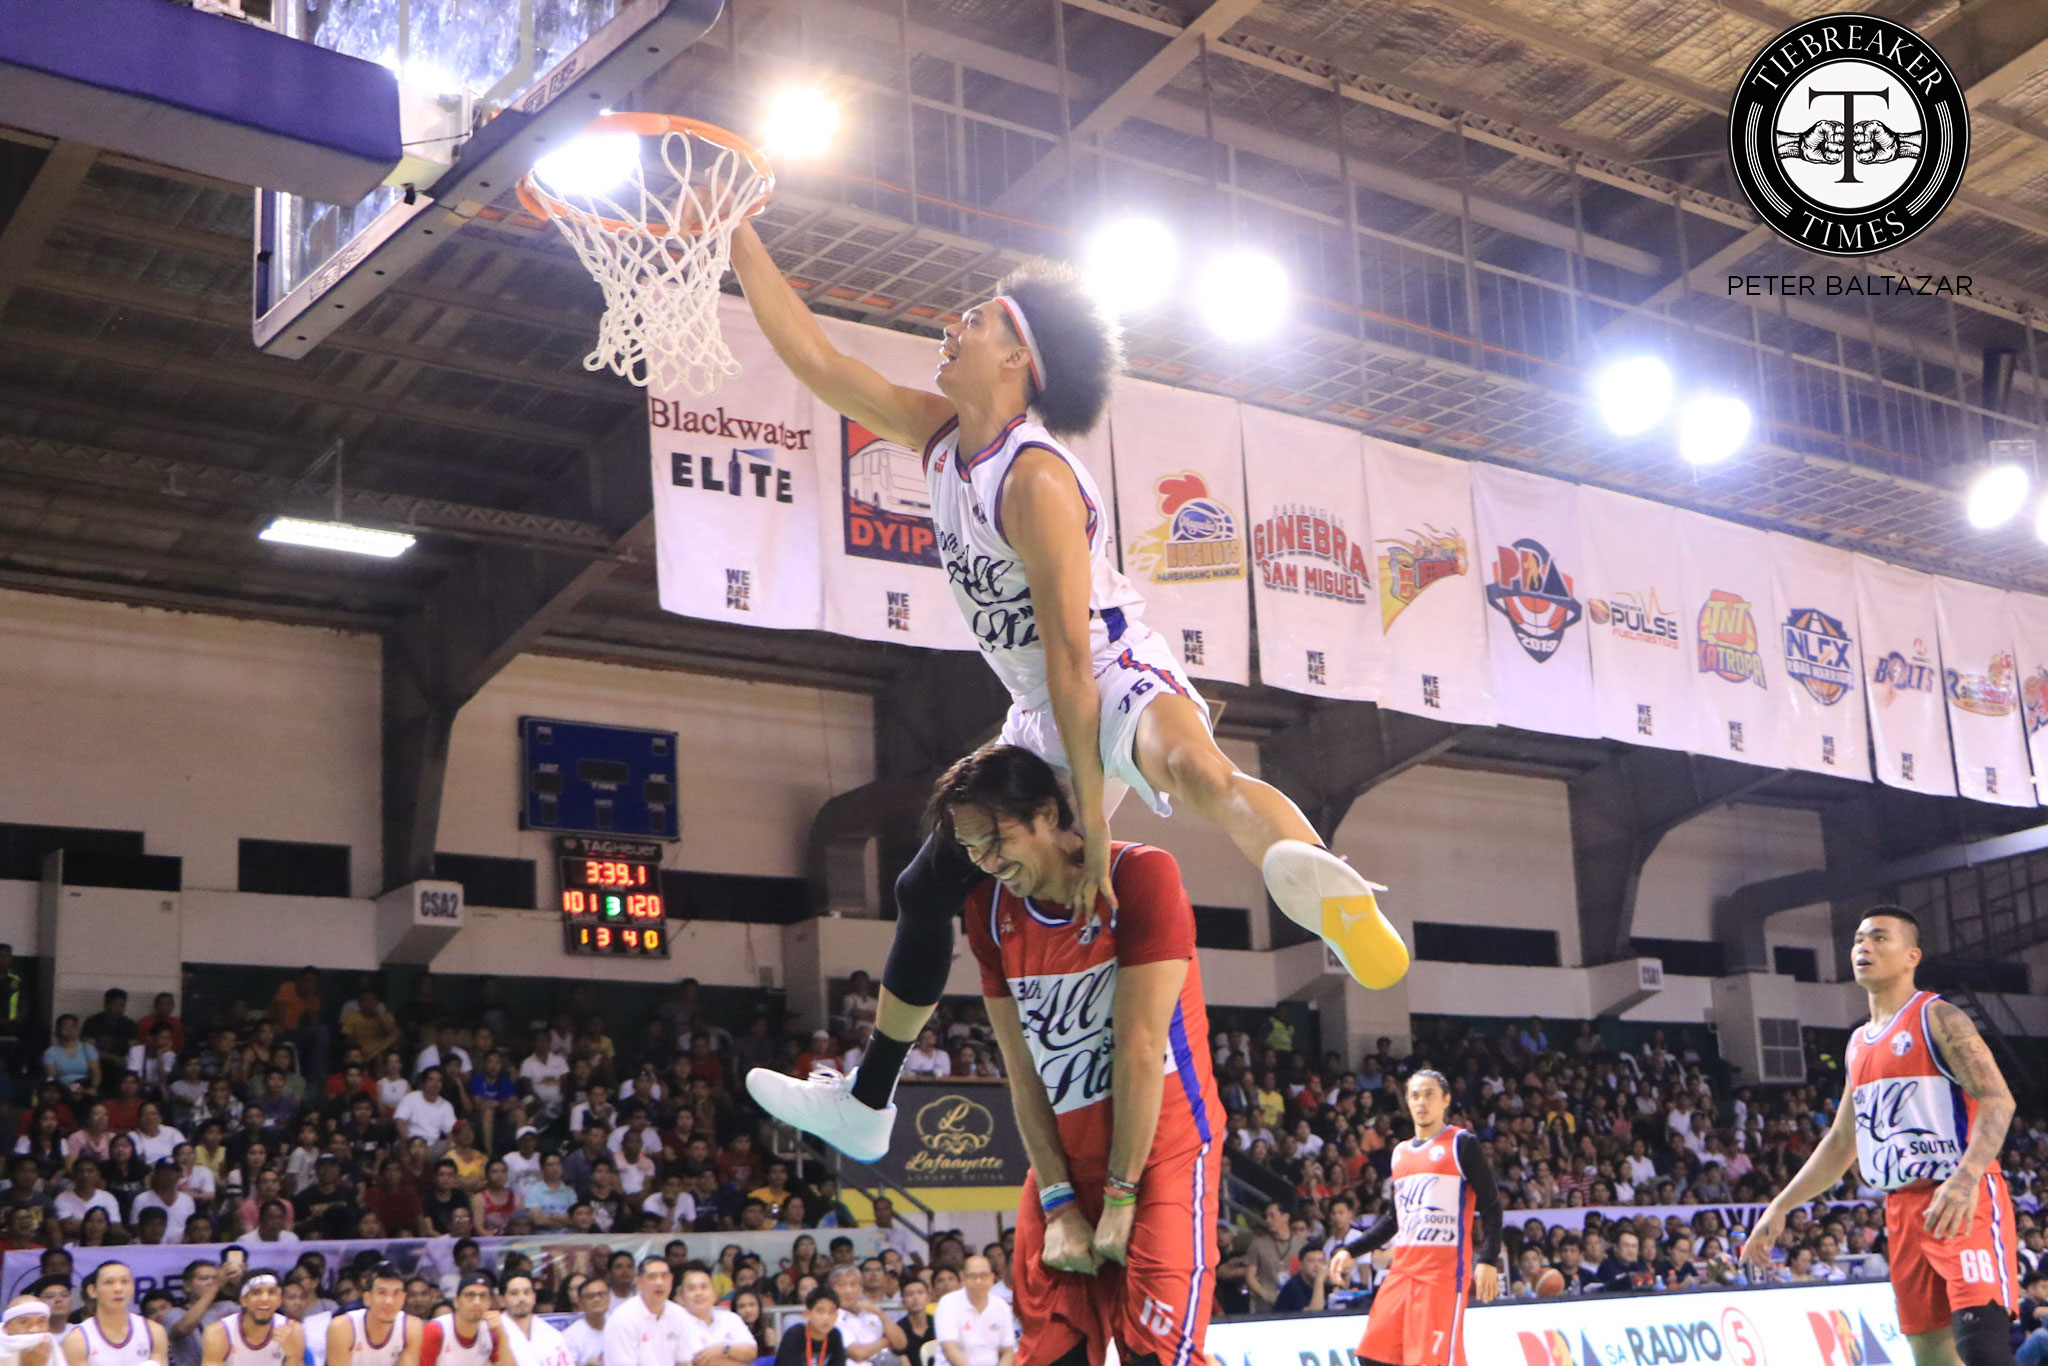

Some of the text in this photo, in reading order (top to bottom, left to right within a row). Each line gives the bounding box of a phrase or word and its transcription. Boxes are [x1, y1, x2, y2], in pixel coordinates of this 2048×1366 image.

[650, 397, 812, 451] Blackwater
[671, 449, 794, 504] ELITE
[850, 517, 935, 554] DYIP
[1254, 514, 1372, 587] GINEBRA
[726, 569, 750, 585] WE
[1262, 560, 1366, 601] SAN MIGUEL
[886, 591, 909, 607] WE
[1611, 607, 1678, 641] PULSE
[1517, 632, 1560, 653] 2019
[606, 895, 621, 917] 3
[627, 893, 662, 918] 120
[1025, 964, 1116, 1051] All
[1855, 1081, 1938, 1143] All
[1910, 1139, 1958, 1155] SOUTH
[1424, 1214, 1457, 1225] SOUTH
[1960, 1248, 1996, 1284] 66
[1432, 1331, 1444, 1356] 7
[1605, 1344, 1628, 1365] SA
[1625, 1320, 1722, 1366] RADYO
